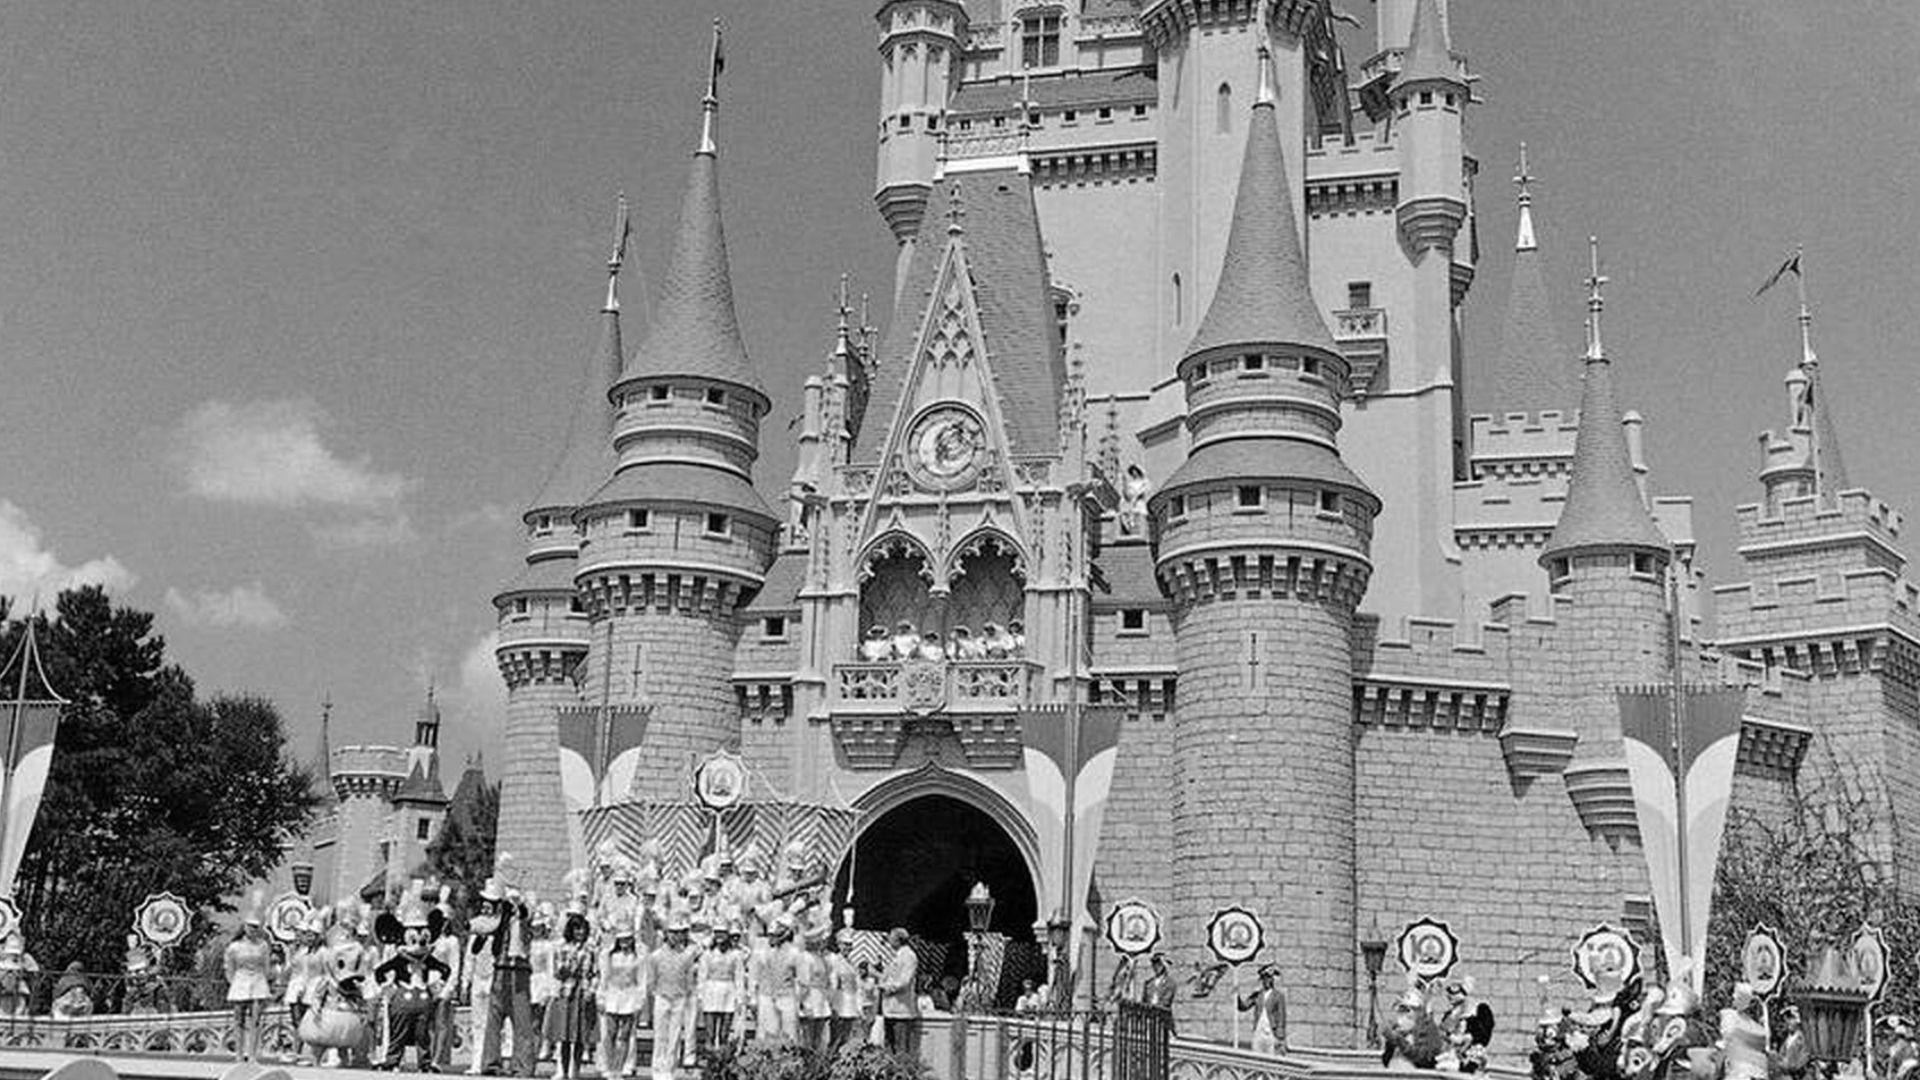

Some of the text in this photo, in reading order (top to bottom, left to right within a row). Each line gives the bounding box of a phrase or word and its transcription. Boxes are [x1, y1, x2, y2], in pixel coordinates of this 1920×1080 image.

[705, 768, 735, 796] 10
[148, 906, 180, 934] 10
[1119, 914, 1150, 941] 10
[1220, 921, 1252, 949] 10
[1410, 934, 1445, 964] 10
